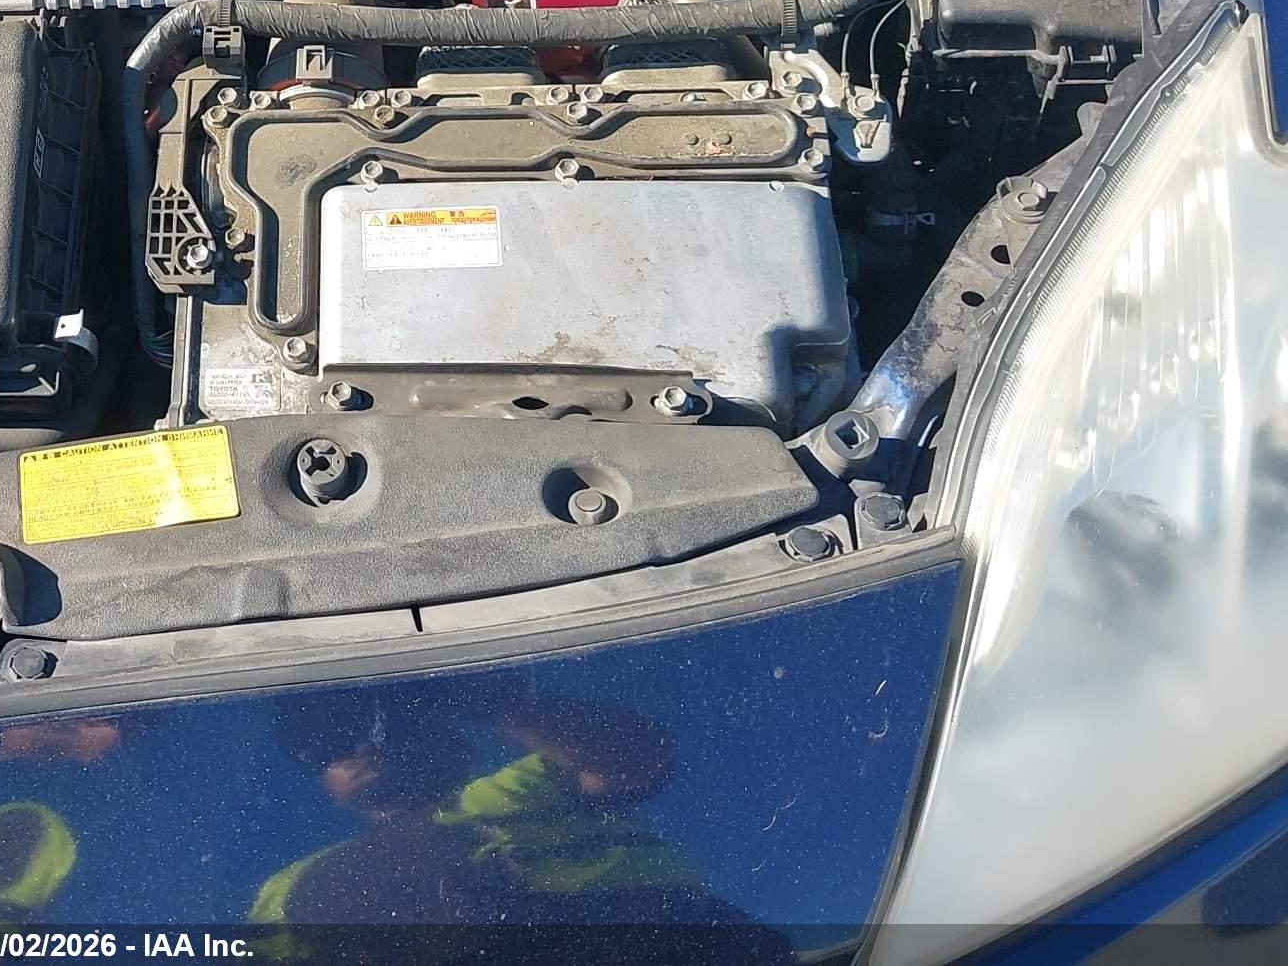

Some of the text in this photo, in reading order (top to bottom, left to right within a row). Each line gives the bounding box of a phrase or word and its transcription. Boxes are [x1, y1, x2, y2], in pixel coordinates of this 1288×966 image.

[403, 211, 436, 219] WARNING
[60, 444, 103, 457] CAUTION
[107, 435, 162, 451] ATTENTION
